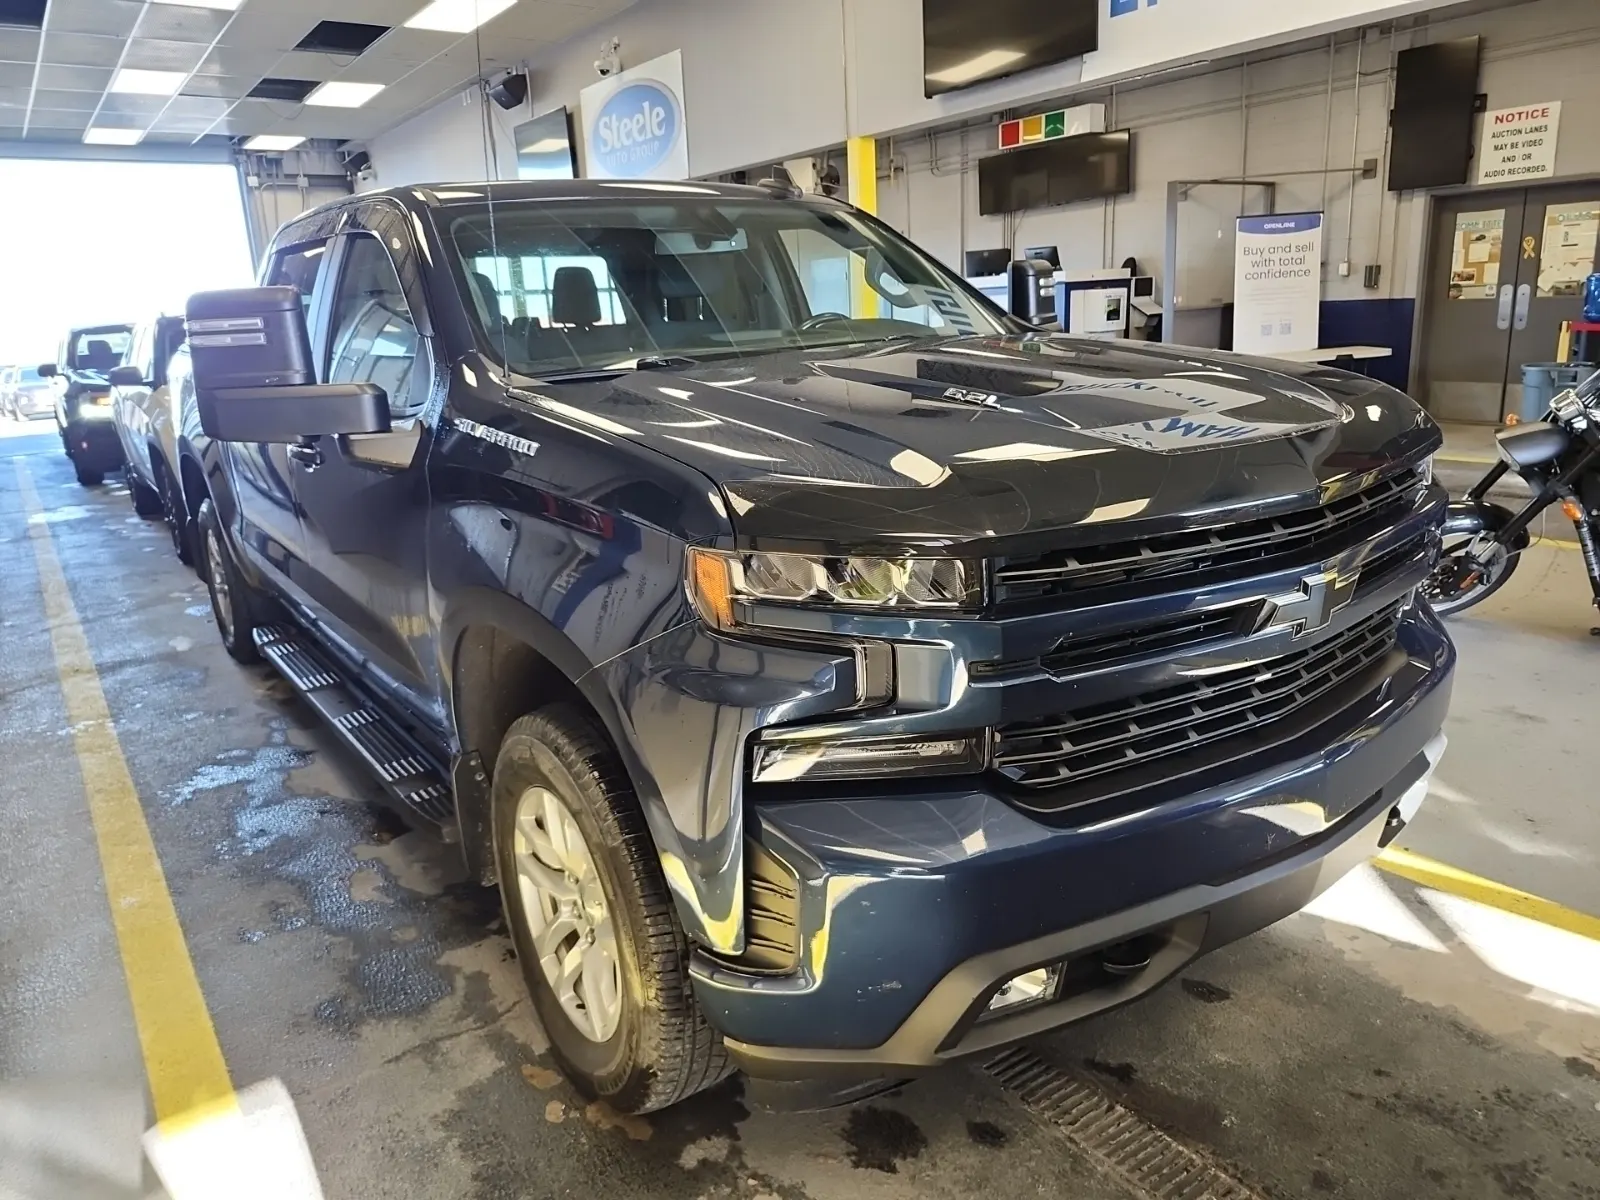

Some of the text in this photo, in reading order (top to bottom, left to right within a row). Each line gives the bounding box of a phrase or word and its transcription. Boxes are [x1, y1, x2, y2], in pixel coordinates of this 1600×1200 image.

[1494, 107, 1550, 125] NOTICE
[598, 100, 666, 154] Steele
[1491, 124, 1548, 139] AUCTION LANES
[1493, 138, 1543, 152] MAY BE VIDEO
[606, 140, 661, 167] AUTO GROUP
[1501, 155, 1516, 163] AND
[1521, 153, 1532, 161] OR
[1484, 164, 1548, 178] AUDIO RECORDED.
[1263, 221, 1296, 229] OPENLANE
[1243, 241, 1314, 258] Buy and sell
[1251, 255, 1306, 268] with total
[1244, 268, 1311, 280] confidence
[453, 418, 540, 457] SILVERADO
